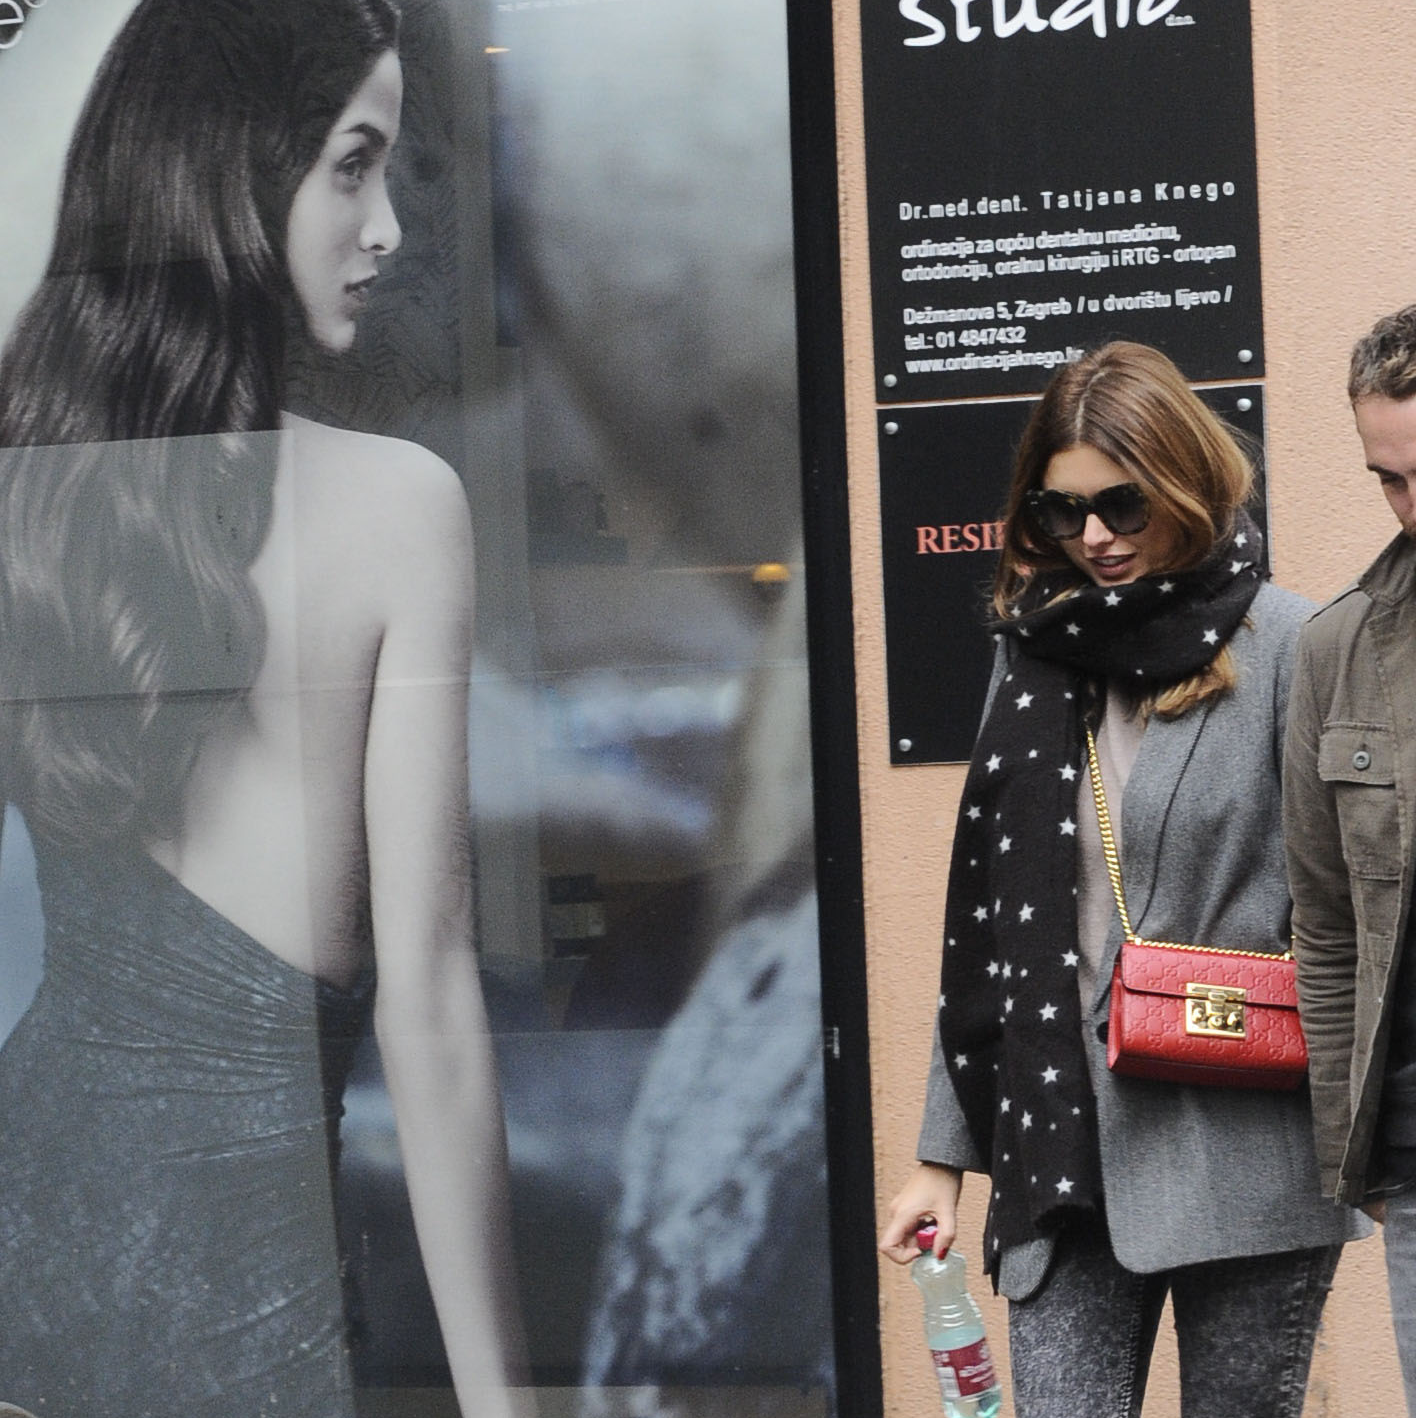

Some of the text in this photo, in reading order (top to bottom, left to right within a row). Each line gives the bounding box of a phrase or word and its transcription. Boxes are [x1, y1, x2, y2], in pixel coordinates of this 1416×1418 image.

[1040, 187, 1142, 210] Tatjana
[1154, 181, 1236, 202] Knego
[901, 236, 975, 259] ordinacija
[975, 239, 994, 254] za
[1036, 228, 1103, 249] dentalnu
[994, 255, 1045, 276] oralnu
[1120, 246, 1160, 267] RTG
[1173, 244, 1237, 265] ortopan
[903, 304, 995, 325] Dežmanova
[1015, 297, 1072, 320] Zagreb
[1175, 288, 1221, 310] lijevo
[935, 330, 955, 349] 01
[958, 326, 1027, 347] 4847432
